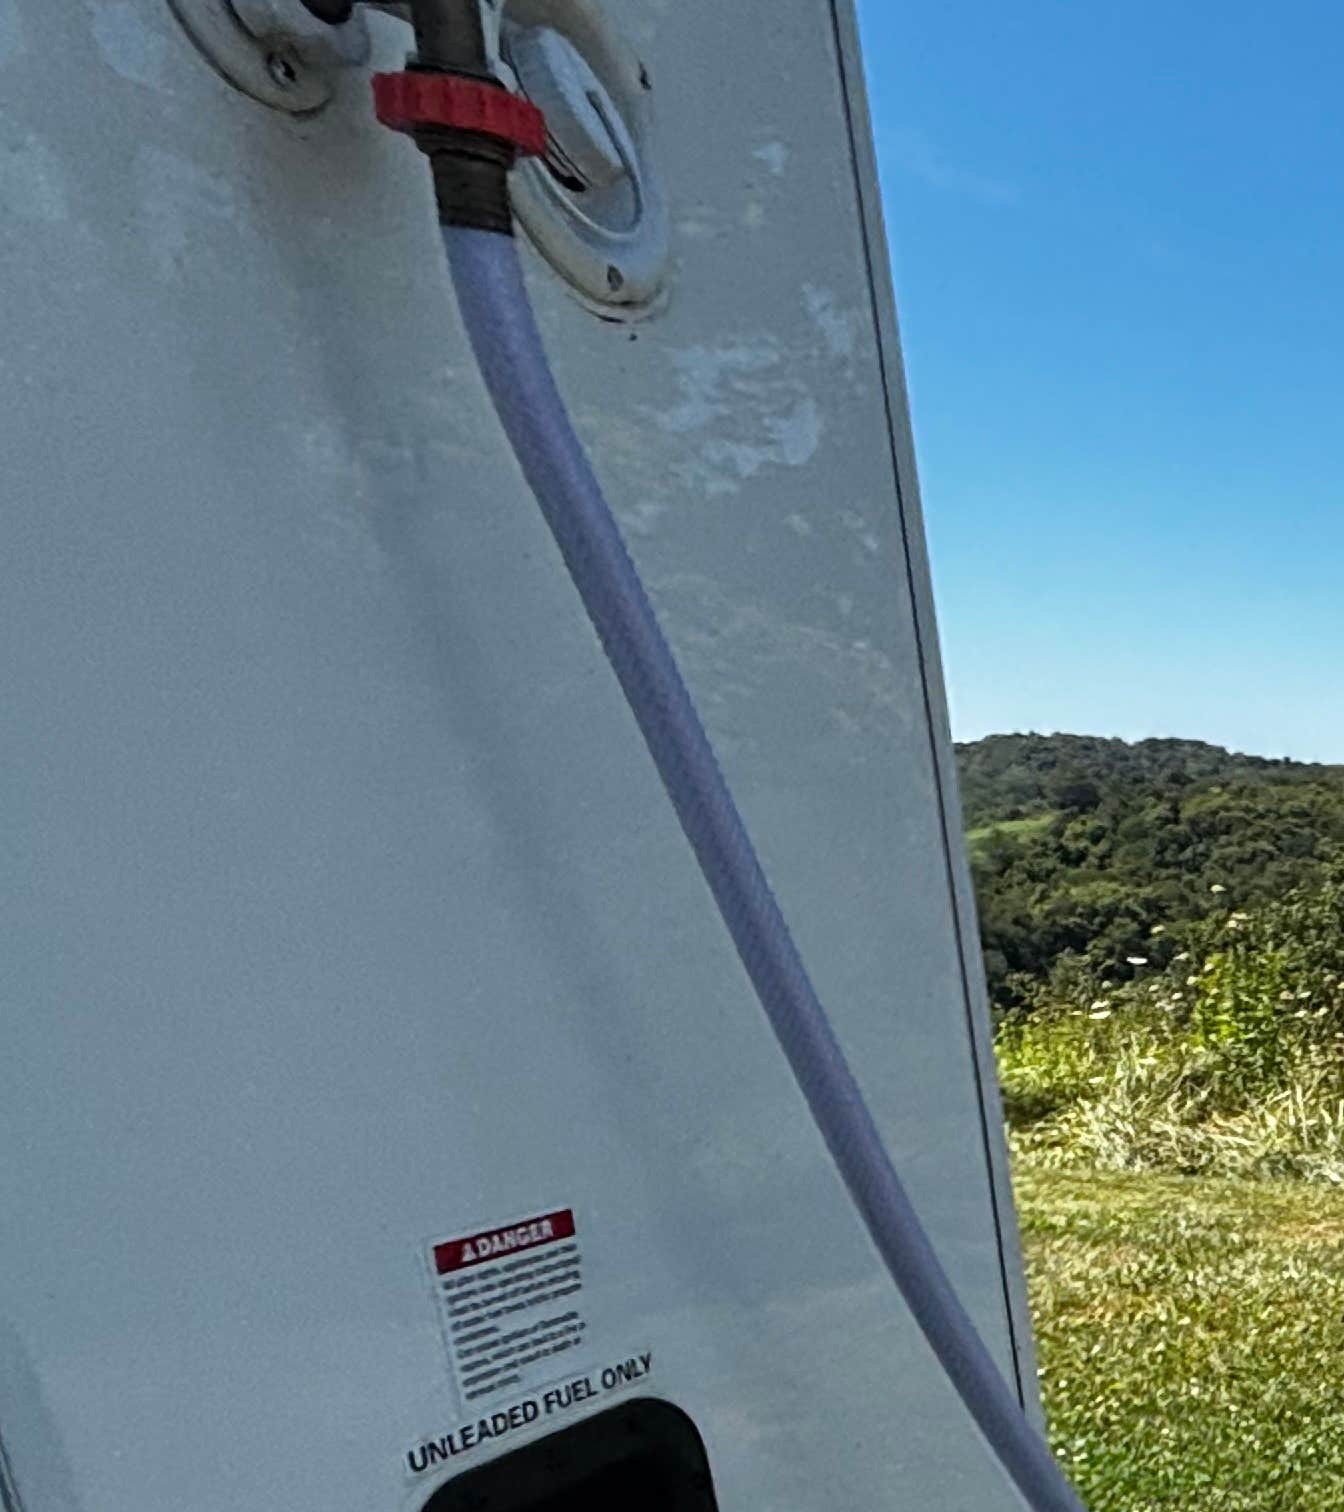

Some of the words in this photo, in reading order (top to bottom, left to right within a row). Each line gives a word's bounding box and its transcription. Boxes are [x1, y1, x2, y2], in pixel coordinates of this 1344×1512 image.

[477, 1219, 554, 1256] DANGER
[407, 1400, 539, 1472] UNLEADED
[543, 1377, 598, 1415] FUEL
[601, 1352, 652, 1390] ONLY
